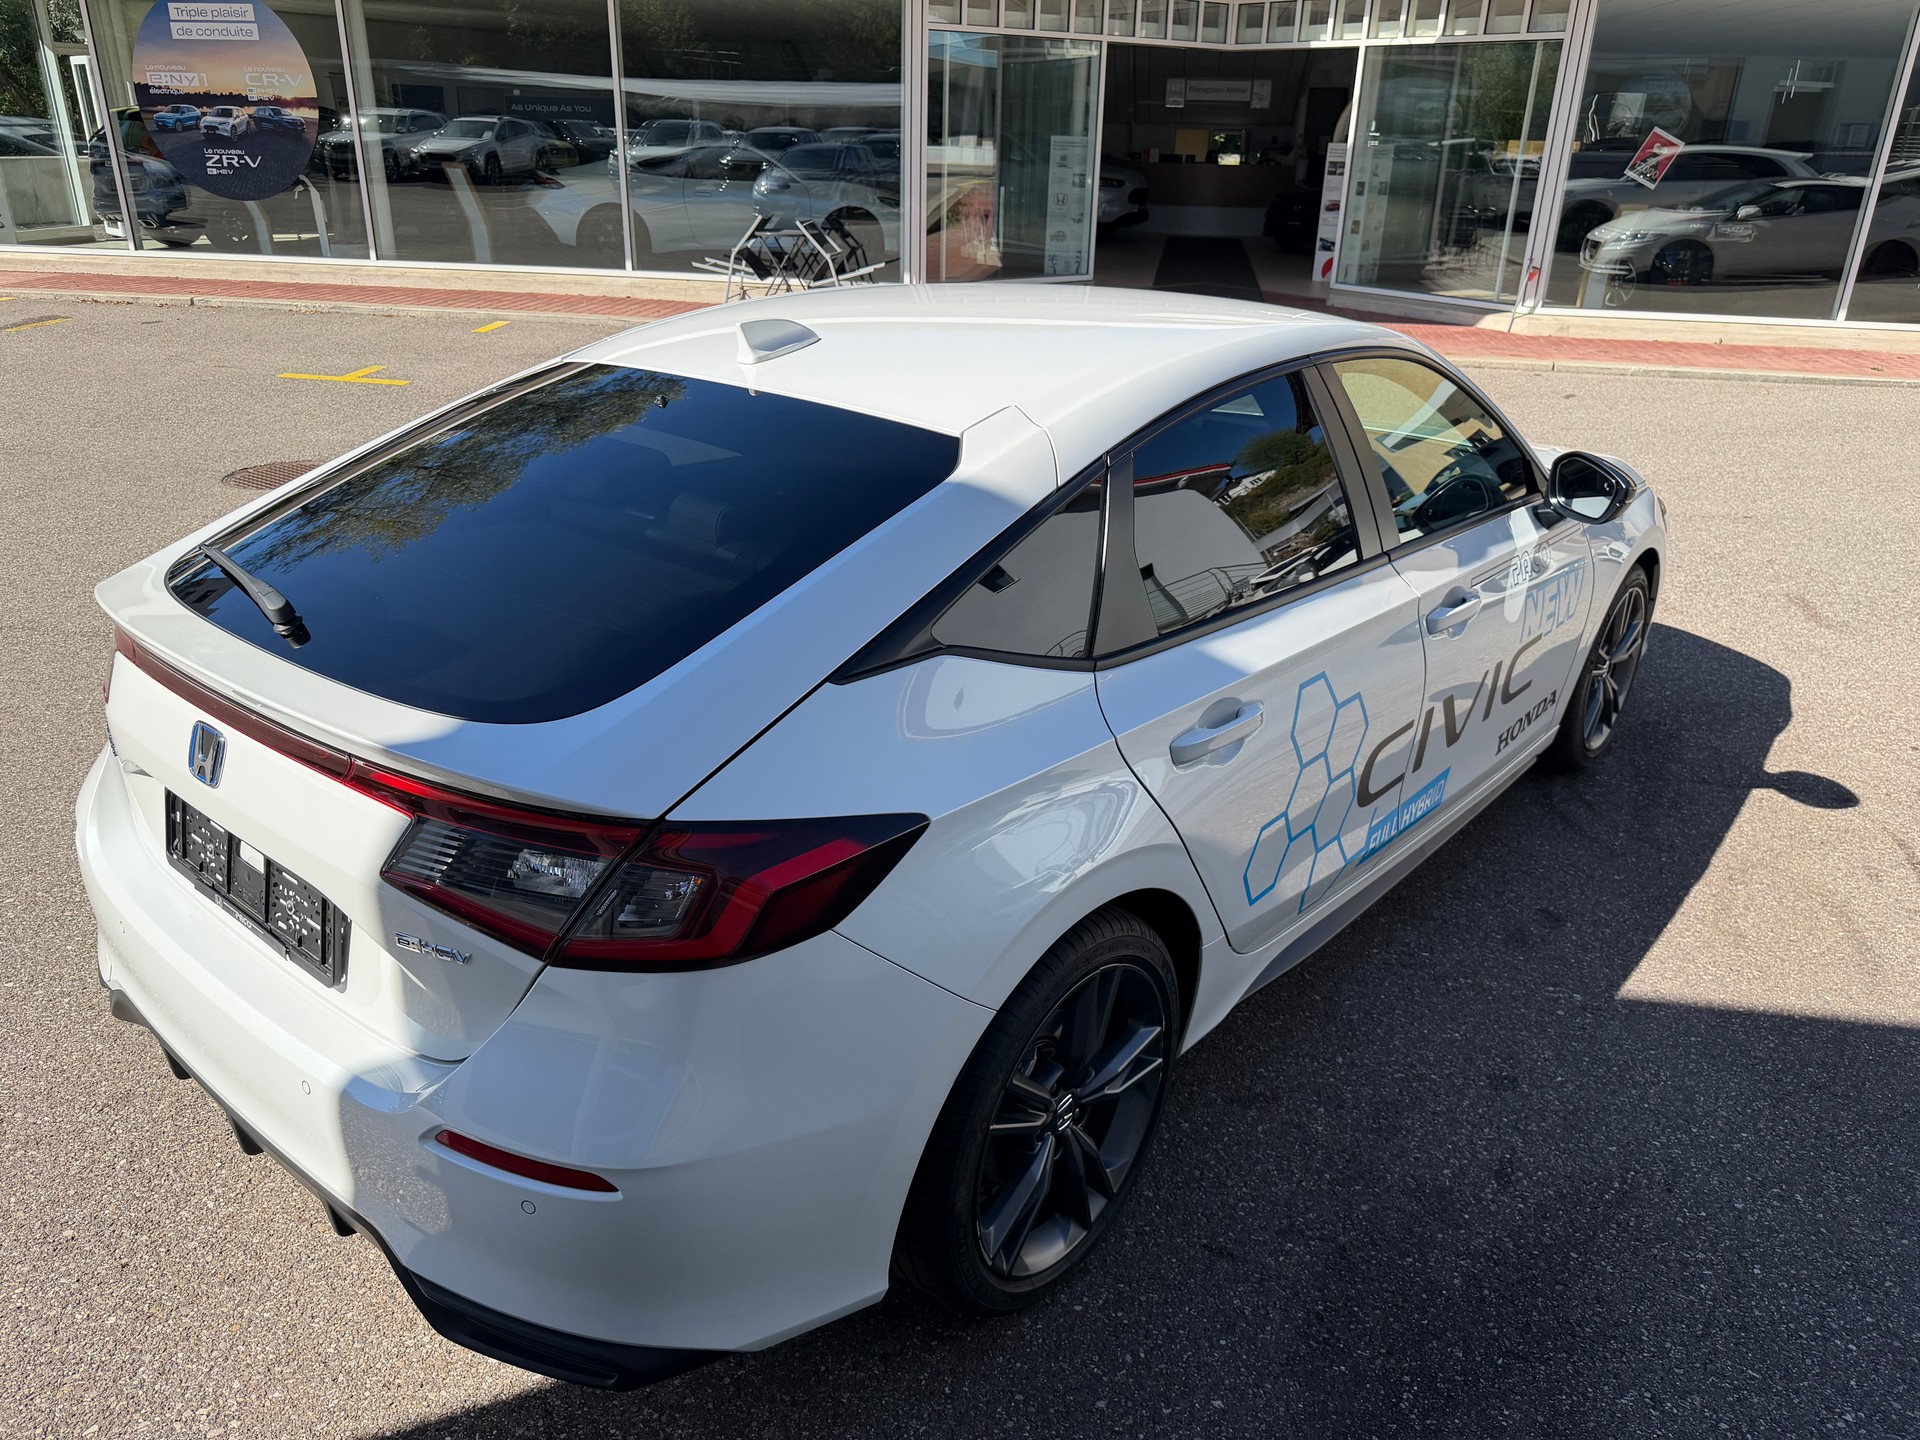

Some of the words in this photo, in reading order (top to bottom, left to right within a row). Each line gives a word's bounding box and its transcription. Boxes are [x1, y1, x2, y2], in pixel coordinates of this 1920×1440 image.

[174, 6, 208, 19] Triple
[211, 7, 249, 19] plaisir
[176, 26, 193, 36] de
[196, 26, 254, 37] conduite
[245, 73, 302, 87] CR-V
[511, 103, 524, 111] As
[525, 103, 559, 113] Unique
[560, 104, 573, 112] As
[574, 105, 592, 113] You
[205, 154, 262, 168] ZR-V
[1519, 556, 1586, 644] NEW
[1356, 632, 1544, 808] CIVIC
[1494, 689, 1558, 756] HONDA
[1400, 779, 1446, 829] HYBRID
[1368, 821, 1399, 851] FULL
